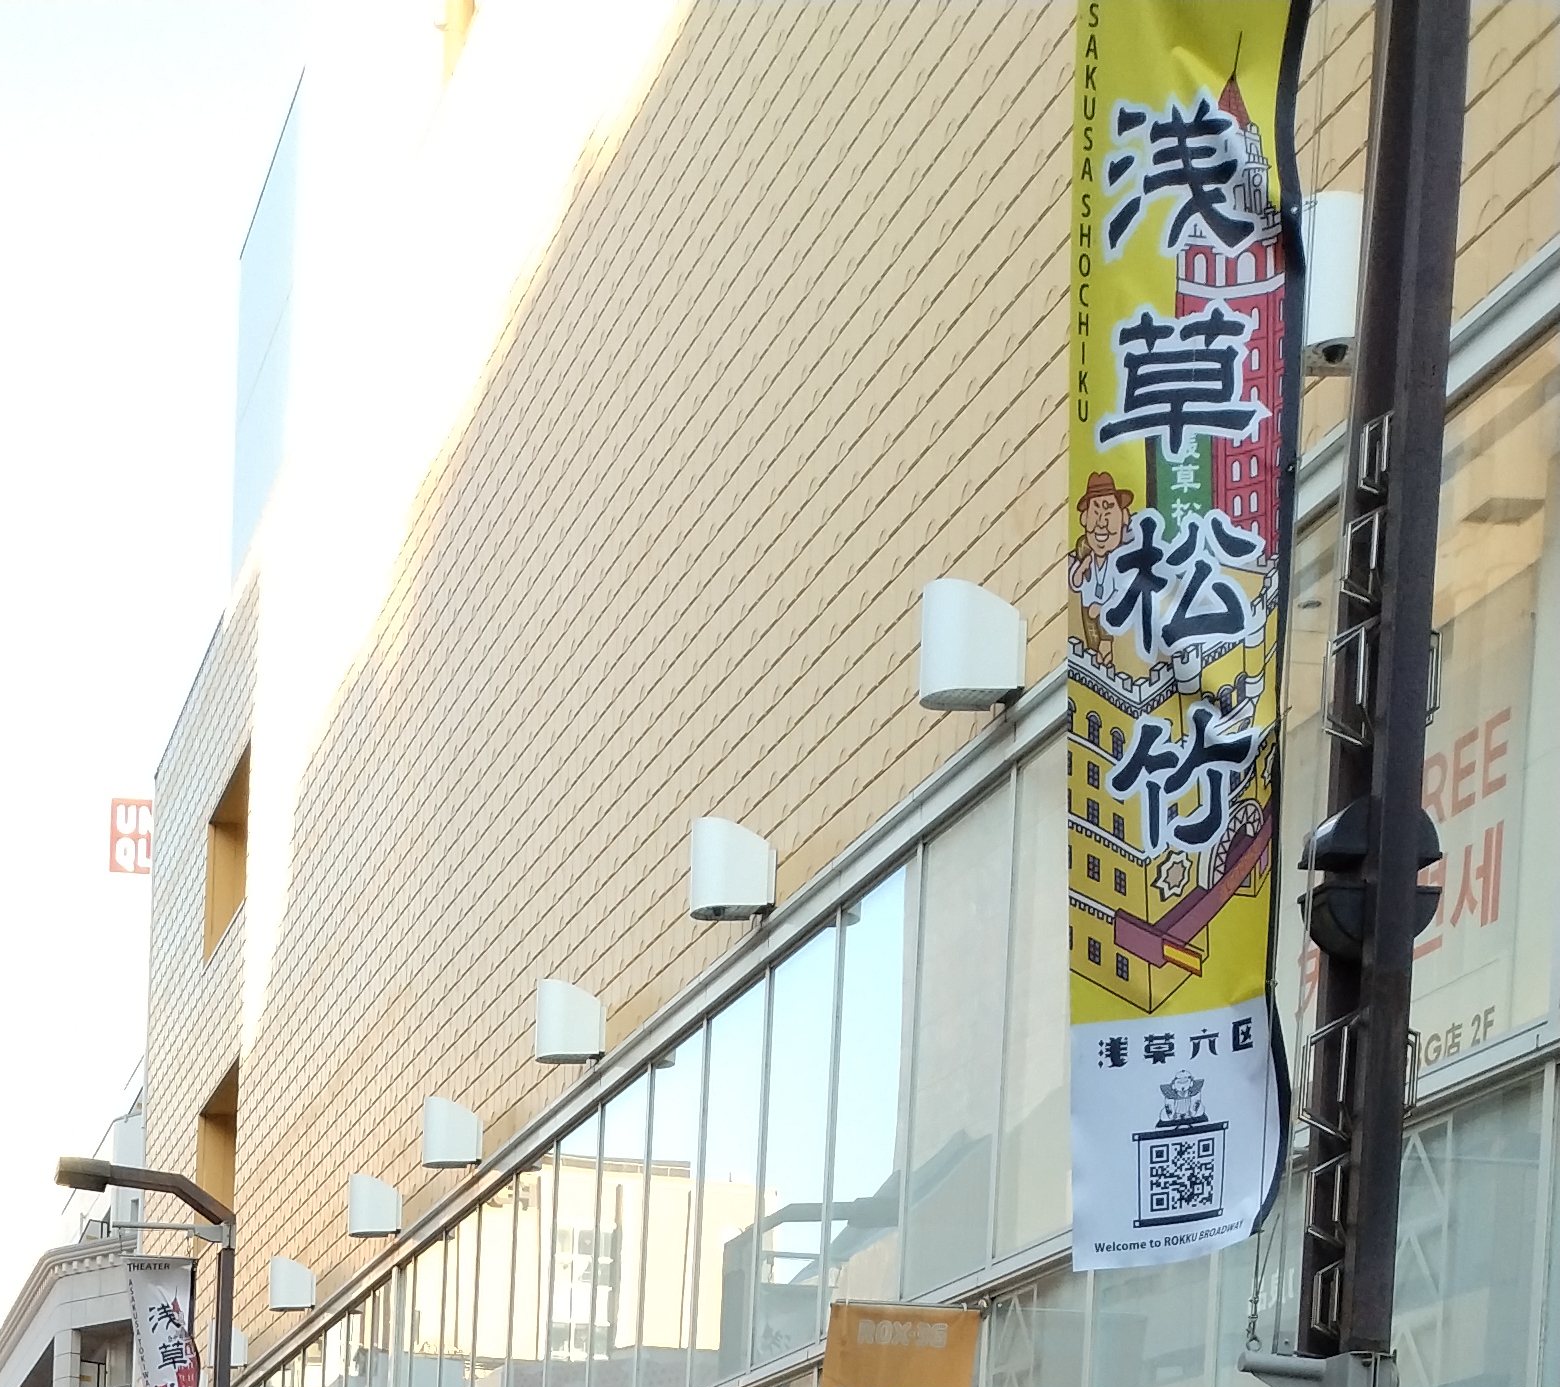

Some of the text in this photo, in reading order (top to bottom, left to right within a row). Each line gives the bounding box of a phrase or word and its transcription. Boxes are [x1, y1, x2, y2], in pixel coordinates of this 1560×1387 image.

[1076, 196, 1093, 424] SHOCHIKU
[1099, 98, 1260, 850] 浅草松竹
[1422, 707, 1512, 824] REE
[1098, 1016, 1254, 1069] 浅草六区
[1470, 1005, 1496, 1047] 2F
[1094, 1219, 1245, 1253] Welcome to ROKKU BROADWAY
[127, 1262, 170, 1272] THEATER
